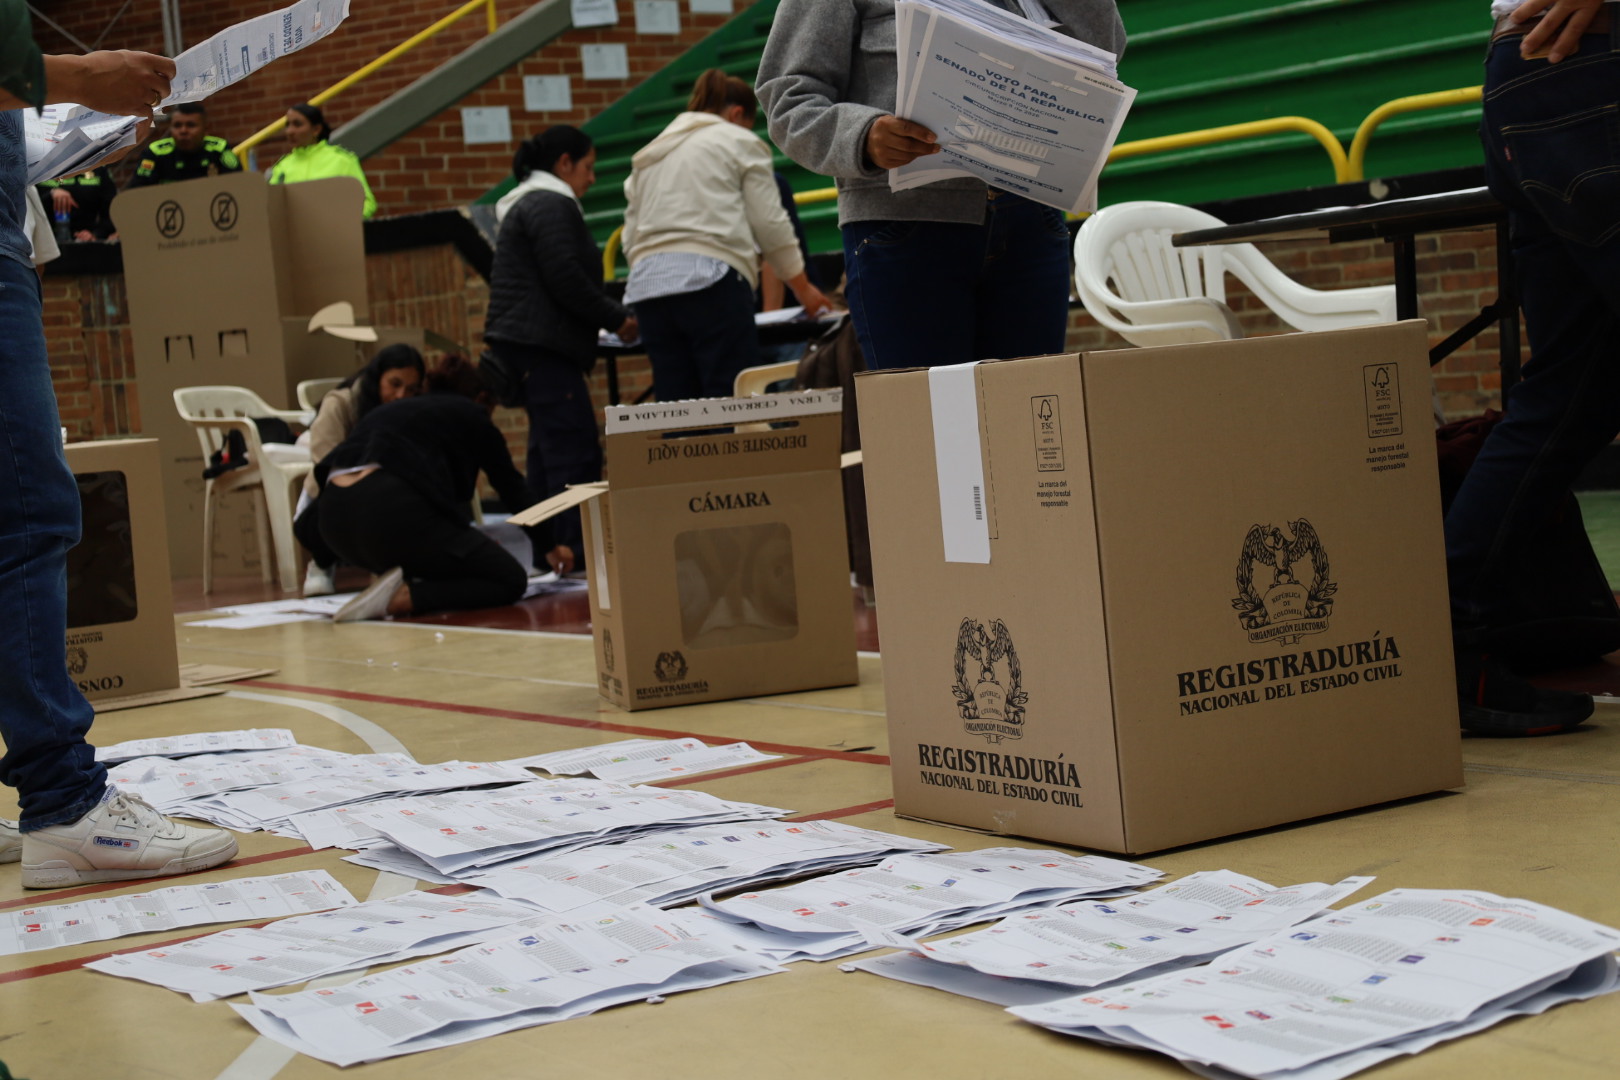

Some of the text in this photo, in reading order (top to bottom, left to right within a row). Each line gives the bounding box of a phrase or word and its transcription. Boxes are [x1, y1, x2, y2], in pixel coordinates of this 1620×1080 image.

[935, 53, 1106, 124] SENADO DE LA REPÚBLICA
[985, 68, 1020, 87] VOTO
[1023, 84, 1058, 102] PARA
[1029, 106, 1068, 122] NACIONAL
[1376, 389, 1391, 397] FSC
[635, 395, 822, 421] URNA CERRADA Y SELLADA
[1041, 422, 1054, 430] FSC
[647, 434, 808, 465] DEPOSITE SU VOTO AQUÍ
[1377, 444, 1395, 453] marca
[1396, 442, 1405, 451] del
[1366, 451, 1409, 464] manejo forestal
[1371, 462, 1406, 473] responsable
[1036, 489, 1071, 499] manejo forestal
[688, 491, 772, 514] CÁMARA
[1040, 500, 1069, 508] responsable
[1271, 591, 1301, 604] REPÚBLICA
[1273, 609, 1303, 620] COLOMBIA
[1250, 620, 1327, 641] ORGANIZACIÓN ELECTORAL
[1177, 630, 1401, 698] REGISTRADURÍA
[635, 679, 709, 696] REGISTRADURÍA
[1179, 663, 1403, 717] NACIONAL DEL ESTADO CIVIL
[980, 707, 1003, 718] COLOMBIA
[965, 720, 1022, 737] ORGANIZACIÓN ELECTORAL
[917, 743, 1082, 789] REGISTRADURÍA
[920, 770, 1084, 808] NACIONAL DEL ESTADO CIVIL
[96, 836, 124, 847] Reebok
